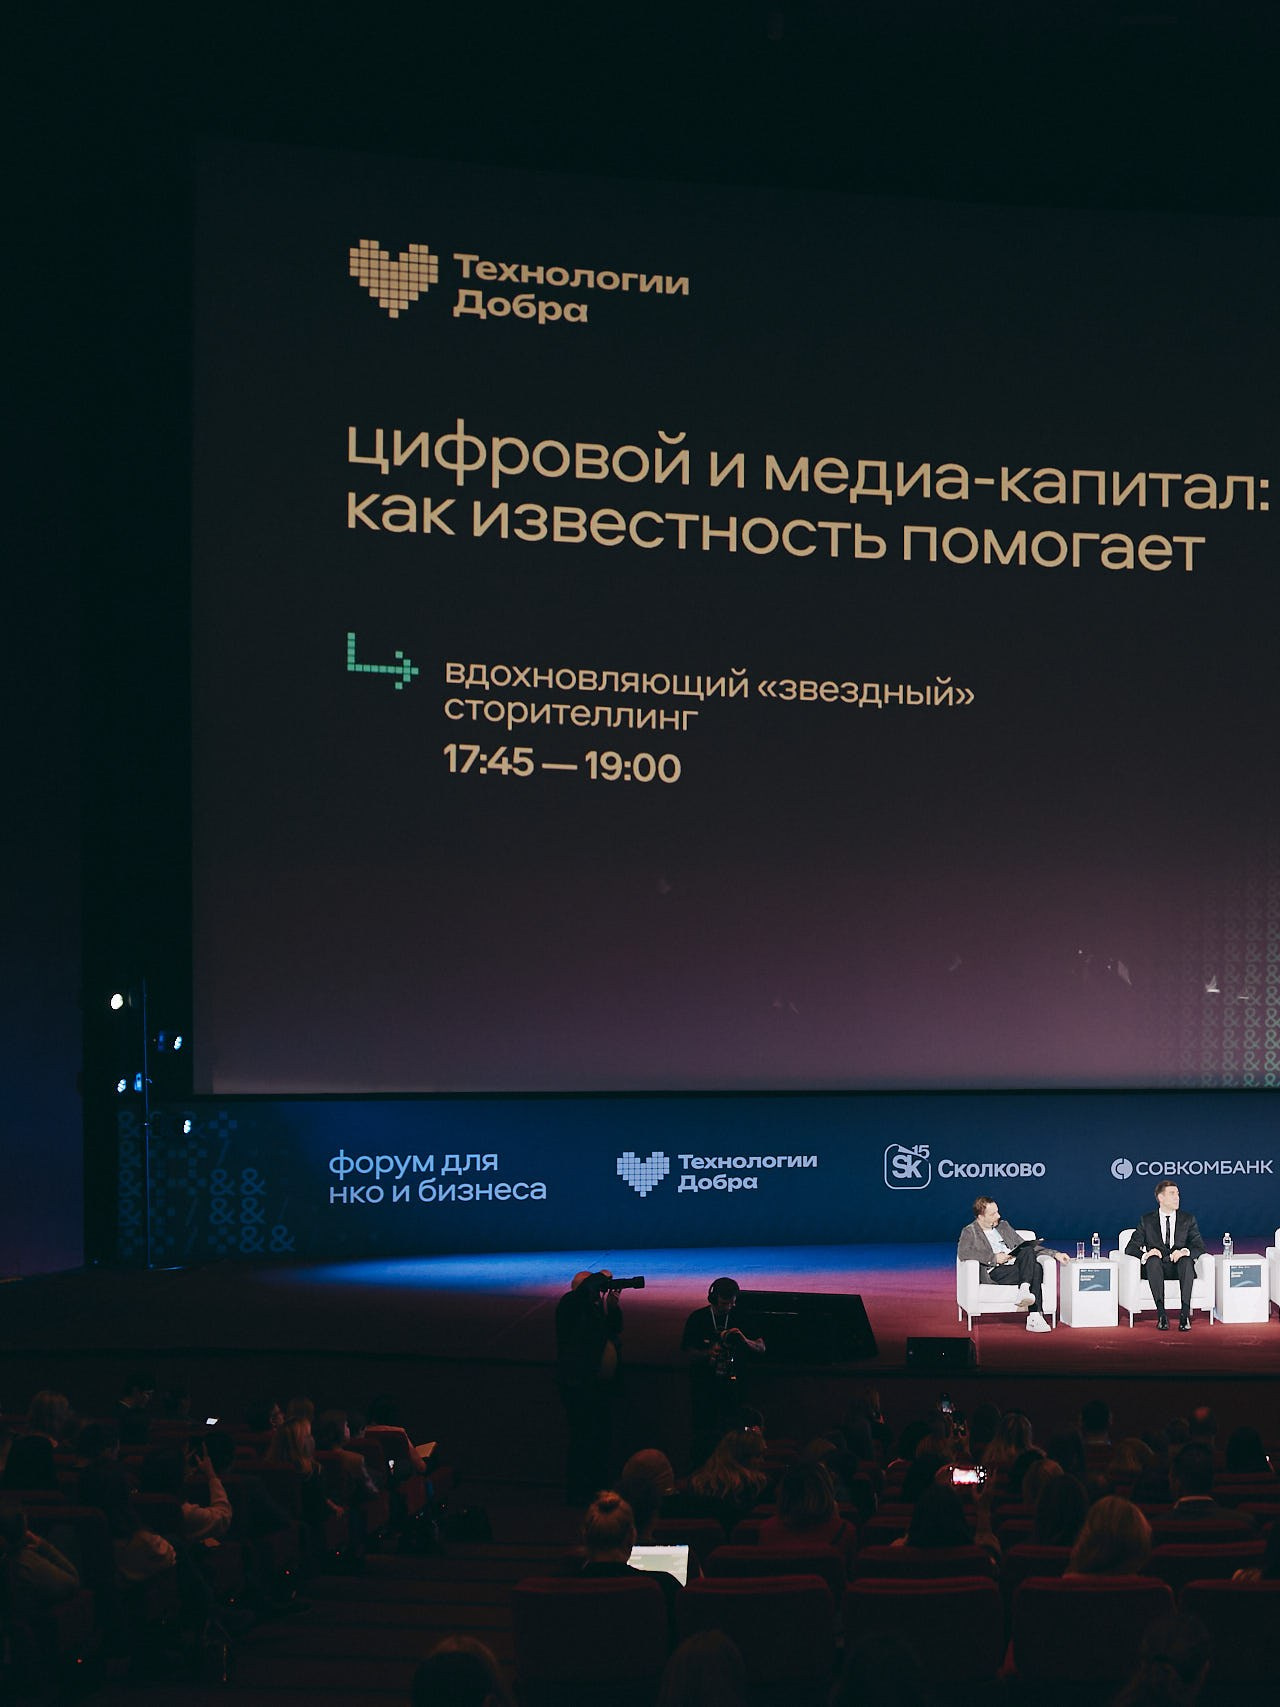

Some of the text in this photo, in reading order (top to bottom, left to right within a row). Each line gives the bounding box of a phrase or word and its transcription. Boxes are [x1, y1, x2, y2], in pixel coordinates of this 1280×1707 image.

[454, 254, 688, 295] Технологии
[453, 289, 587, 324] Добра
[349, 419, 1269, 510] цифровой и медиа-капитал:
[348, 492, 1205, 571] как известность помогает
[445, 662, 974, 708] вдохновляющий «звездный»
[444, 696, 699, 731] сторителлинг
[444, 744, 534, 776] 17:45
[586, 751, 681, 783] 19:00
[329, 1149, 498, 1180] форум для
[678, 1155, 817, 1169] Технологии
[938, 1160, 1045, 1178] Сколково
[1136, 1160, 1273, 1175] СОВКОМБАНК
[330, 1177, 547, 1203] нко и бизнеса
[678, 1174, 757, 1192] Добра
